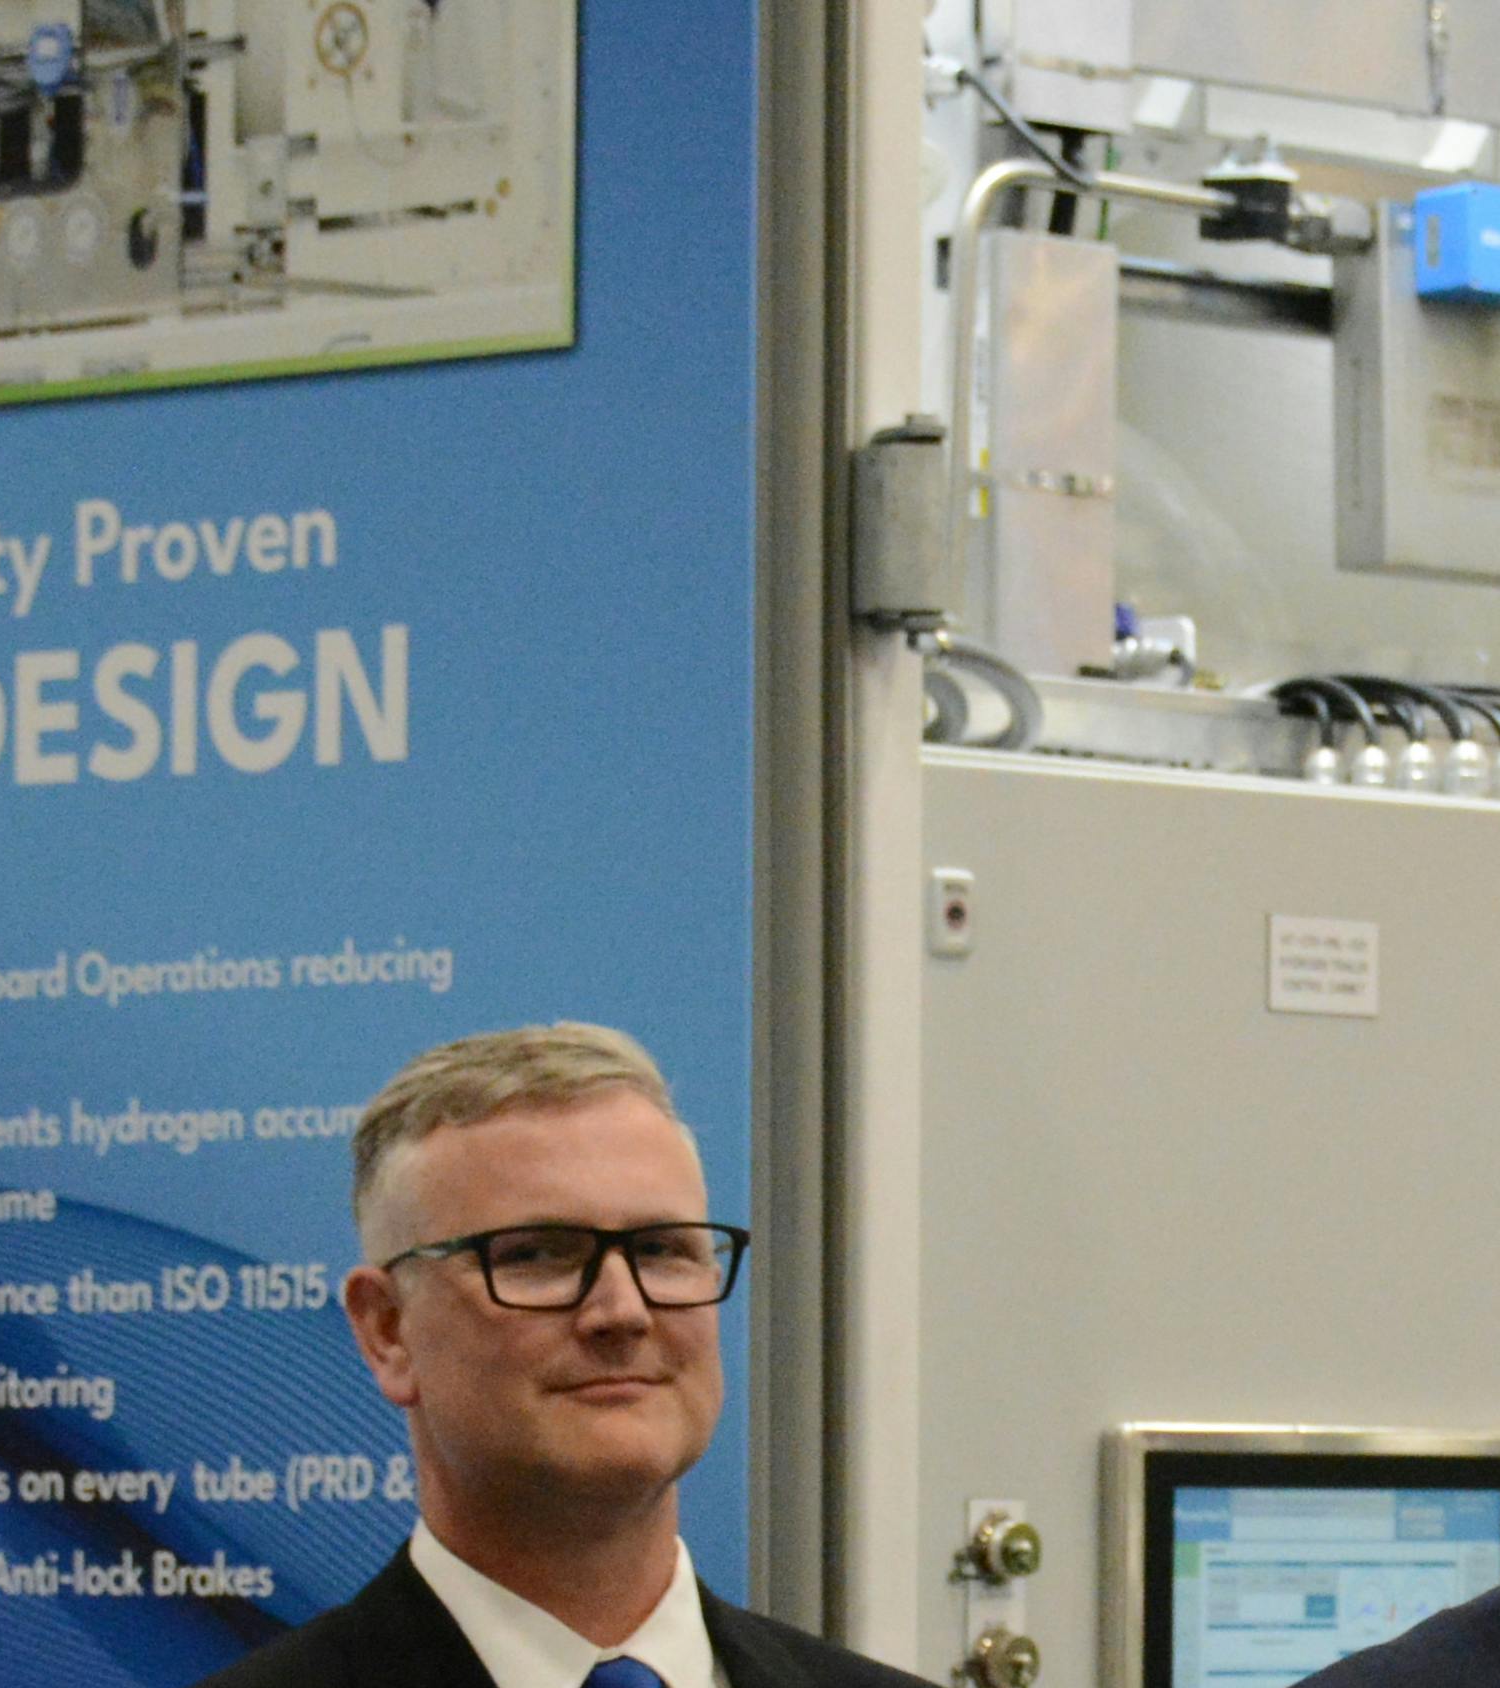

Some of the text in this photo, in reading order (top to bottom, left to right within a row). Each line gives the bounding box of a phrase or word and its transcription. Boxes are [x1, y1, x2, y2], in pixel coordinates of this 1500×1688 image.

[76, 498, 337, 588] Proven
[75, 945, 282, 1006] Operations
[291, 935, 454, 993] reducing
[70, 1097, 245, 1156] hydrogen
[67, 1267, 153, 1314] than
[162, 1264, 231, 1313] ISO
[238, 1262, 329, 1311] 11515
[18, 1471, 65, 1503] on
[73, 1469, 176, 1514] every
[192, 1456, 276, 1501] tube
[286, 1454, 374, 1514] (PRD
[382, 1453, 416, 1502] &
[151, 1549, 275, 1598] Brakes
